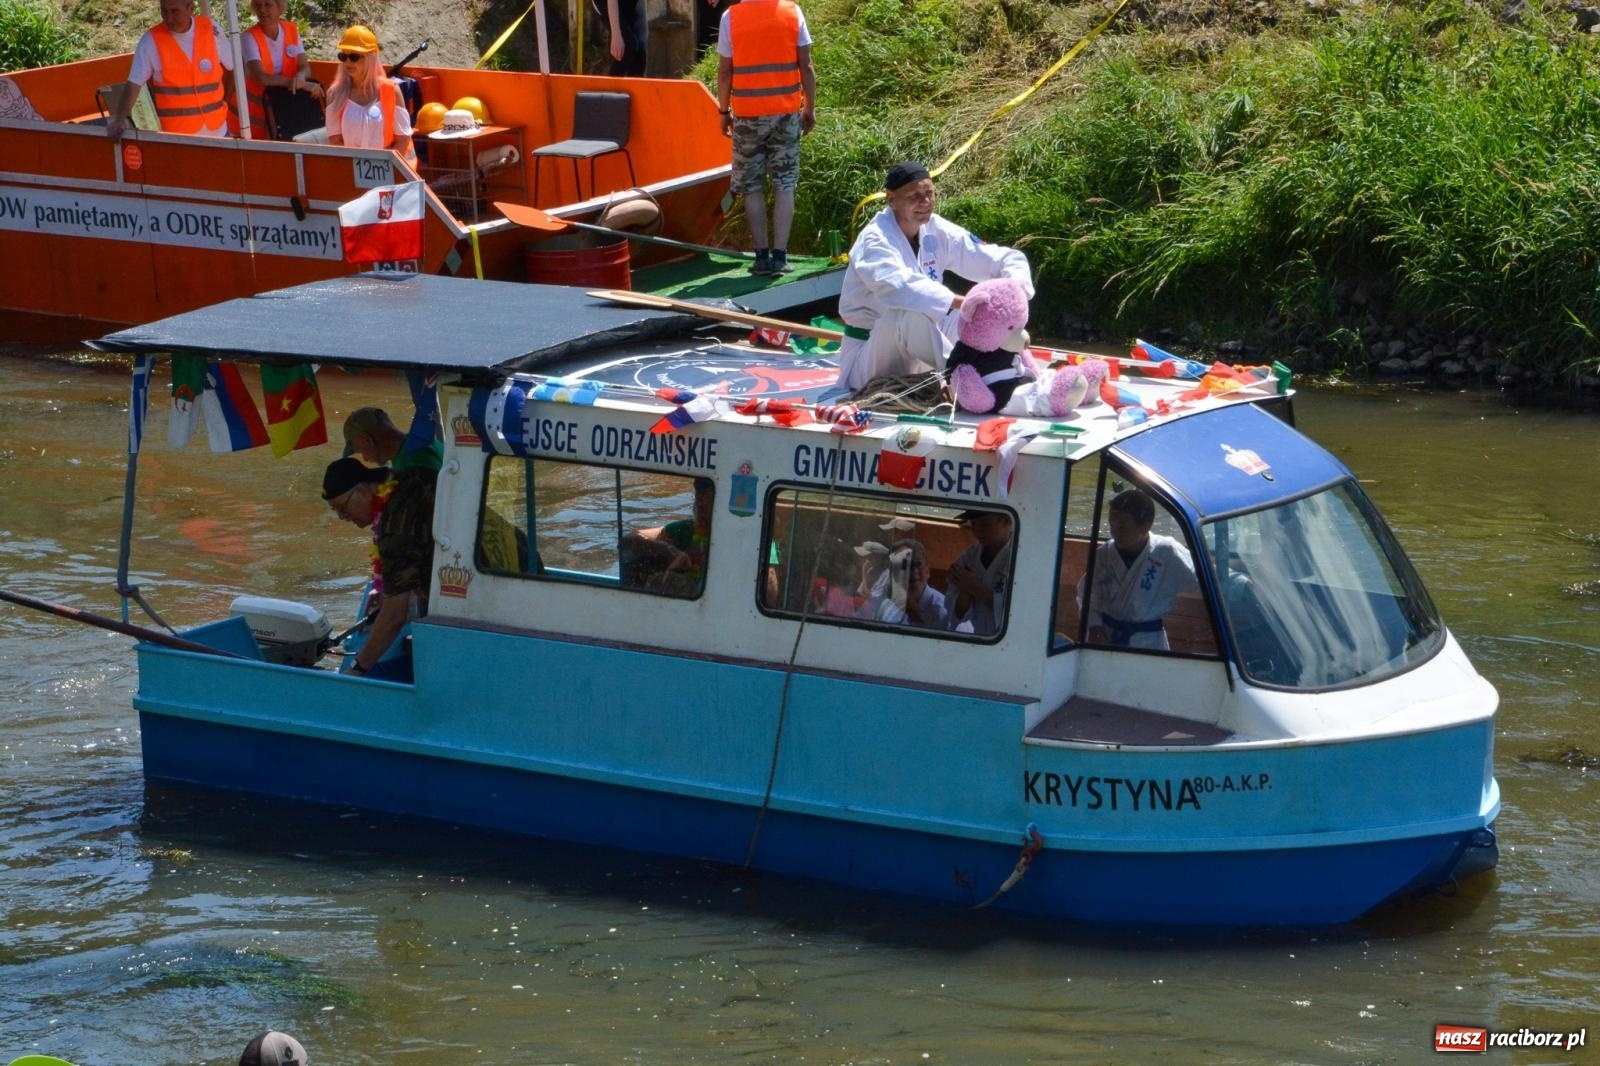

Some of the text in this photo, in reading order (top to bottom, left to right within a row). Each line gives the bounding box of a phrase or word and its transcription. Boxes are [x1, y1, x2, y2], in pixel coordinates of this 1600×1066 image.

[34, 201, 144, 237] pamiętamy,
[150, 215, 161, 232] a
[166, 211, 226, 245] ODRĘ
[230, 222, 337, 255] sprzątamy!
[520, 417, 578, 454] EJSCE
[1024, 770, 1273, 811] KRYSTYNA 80-A.K.P.
